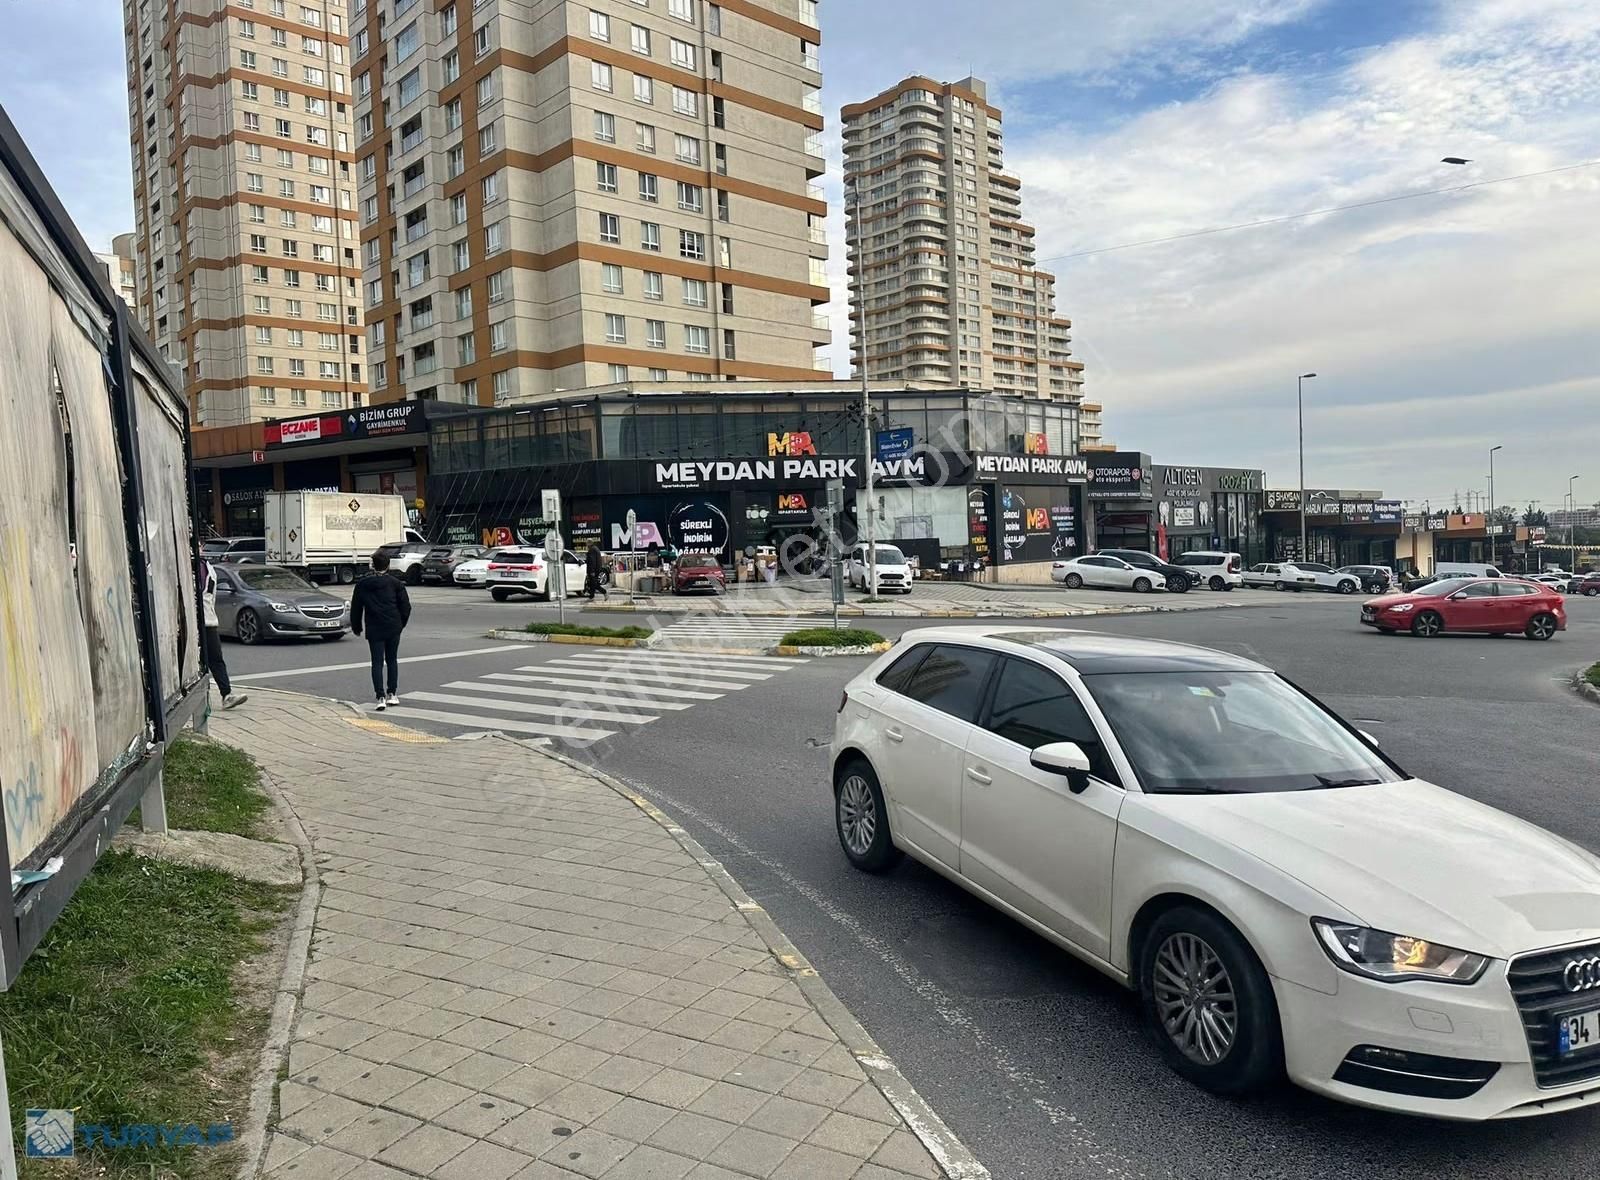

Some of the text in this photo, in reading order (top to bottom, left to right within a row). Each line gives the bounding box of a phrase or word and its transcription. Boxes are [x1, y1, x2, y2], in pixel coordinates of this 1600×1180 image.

[360, 406, 411, 422] BİZİM GRUP
[282, 421, 318, 435] ECZANE
[367, 419, 406, 430] GAYRİMENKUL
[903, 440, 908, 449] 9
[656, 457, 924, 482] MEYDAN PARK AVM
[977, 456, 1087, 475] MEYDAN PARK AVM
[1095, 468, 1130, 476] OTORAPOR
[1164, 468, 1203, 485] ALTIGEN
[1322, 503, 1340, 513] MOTORS
[680, 519, 712, 529] SÜREKLİ
[684, 532, 712, 543] İNDİRİM
[1570, 1016, 1589, 1045] 34
